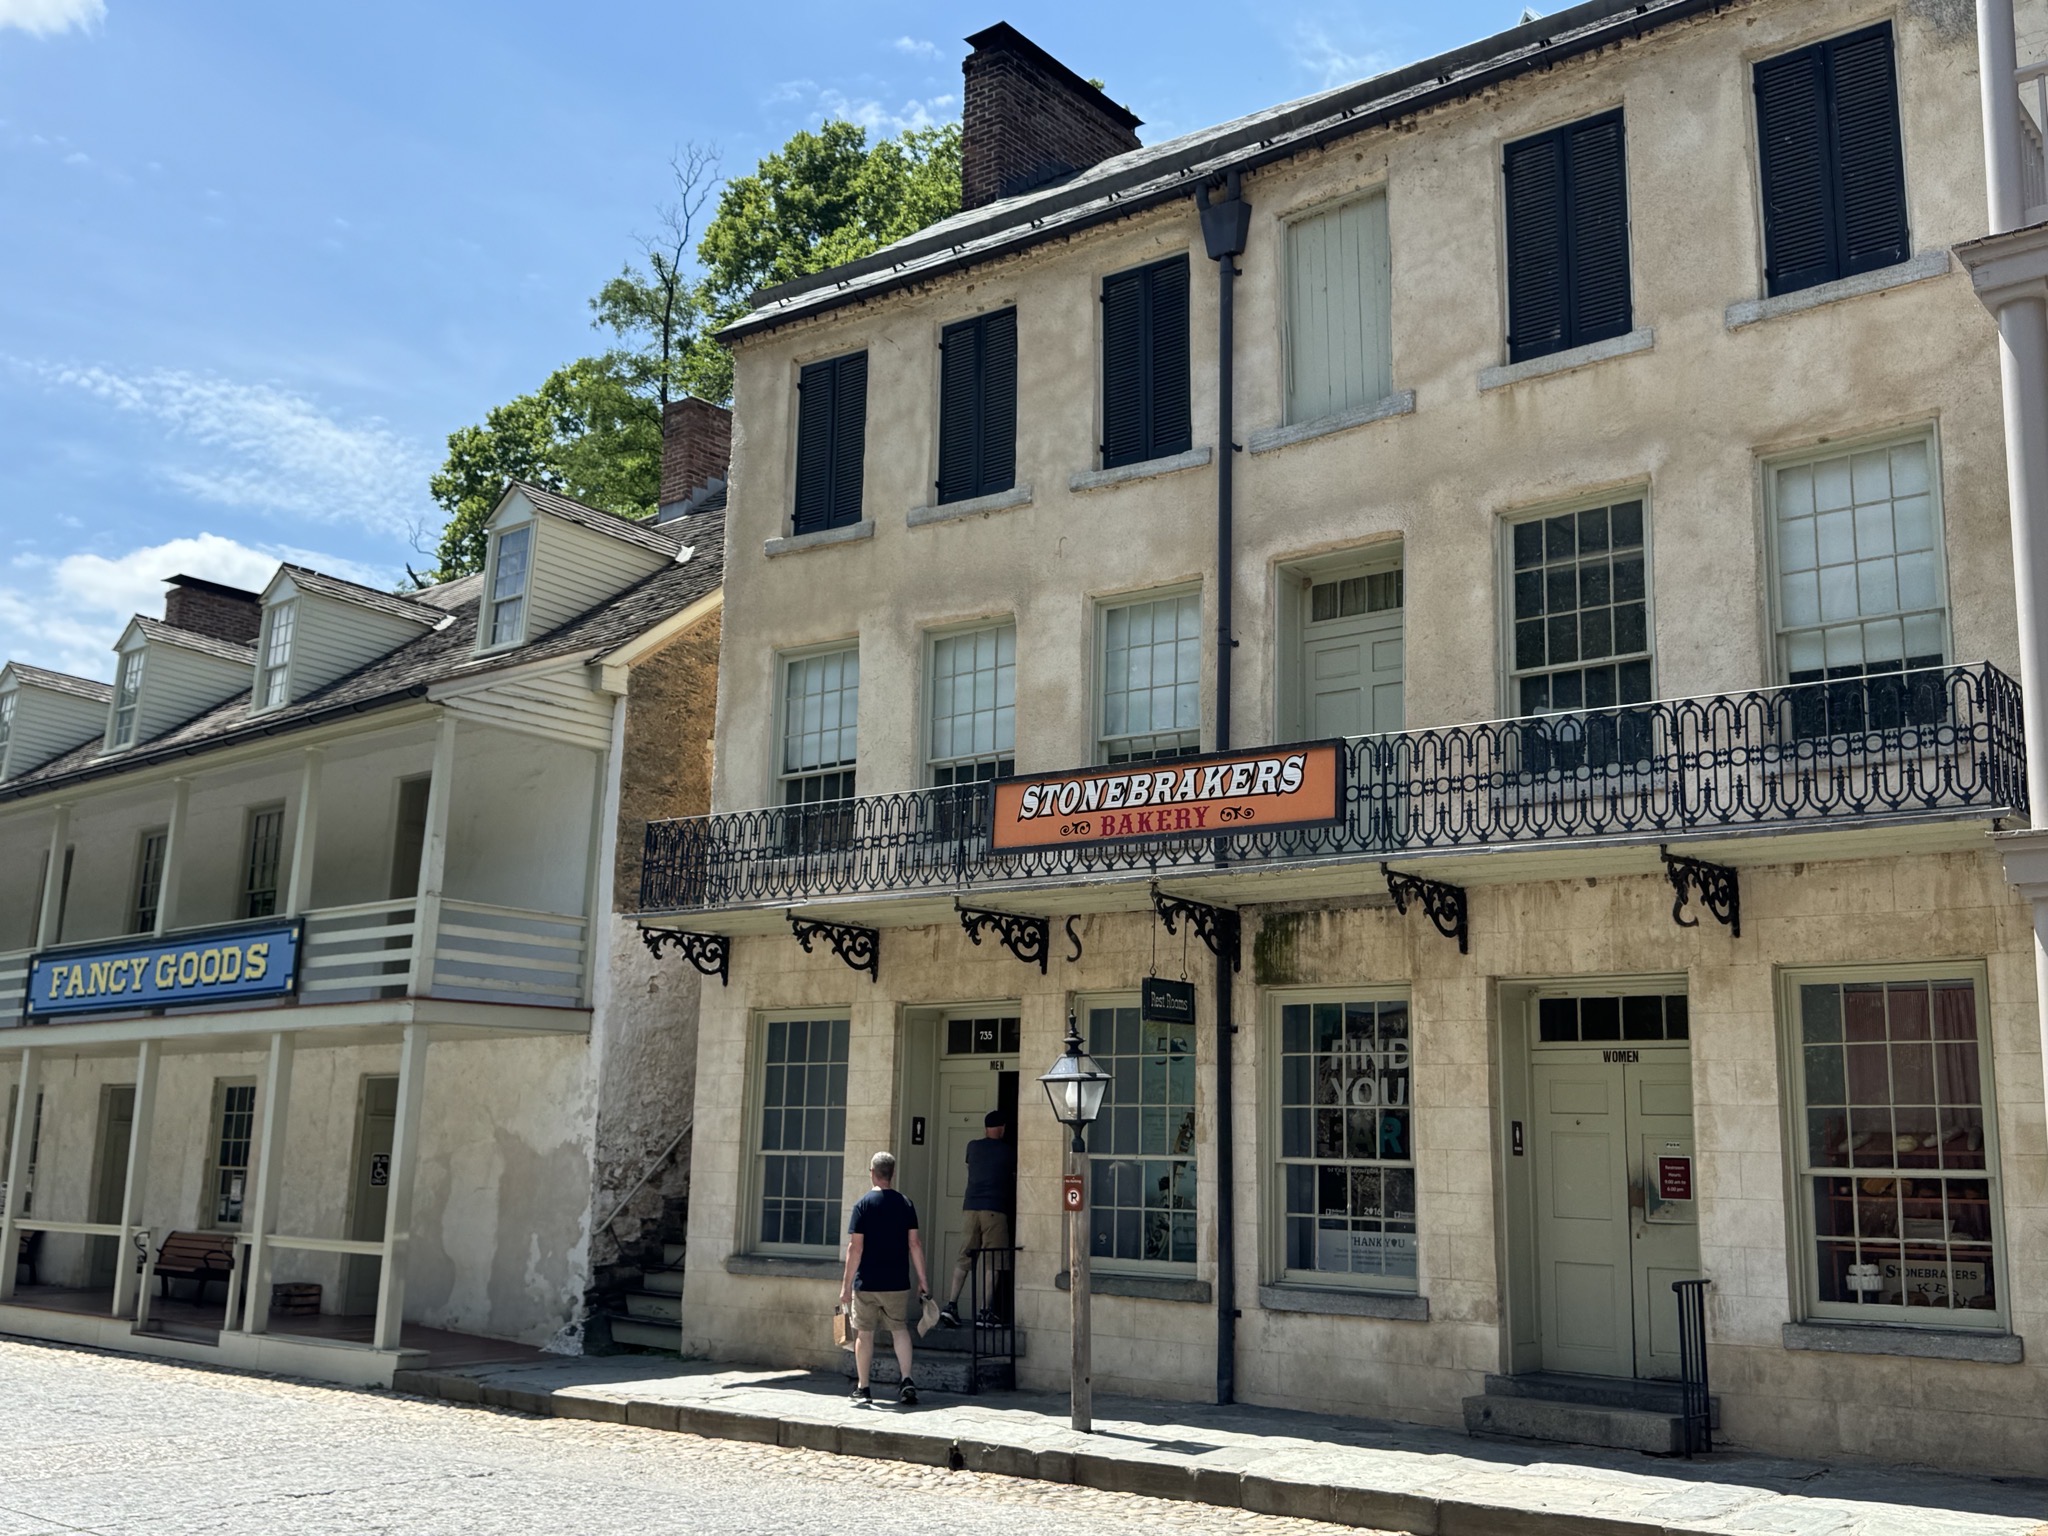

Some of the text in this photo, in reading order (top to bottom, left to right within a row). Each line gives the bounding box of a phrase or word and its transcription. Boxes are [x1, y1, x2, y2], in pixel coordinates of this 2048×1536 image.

[1018, 752, 1307, 822] STONEBRAKERS
[1100, 806, 1211, 837] BAKERY
[49, 942, 269, 998] FANCY GOODS
[1151, 991, 1188, 1011] Rest Rooms
[979, 1031, 993, 1040] 735
[990, 1061, 1004, 1071] MEN
[1331, 1038, 1410, 1070] FIND
[1603, 1050, 1639, 1063] WOMEN
